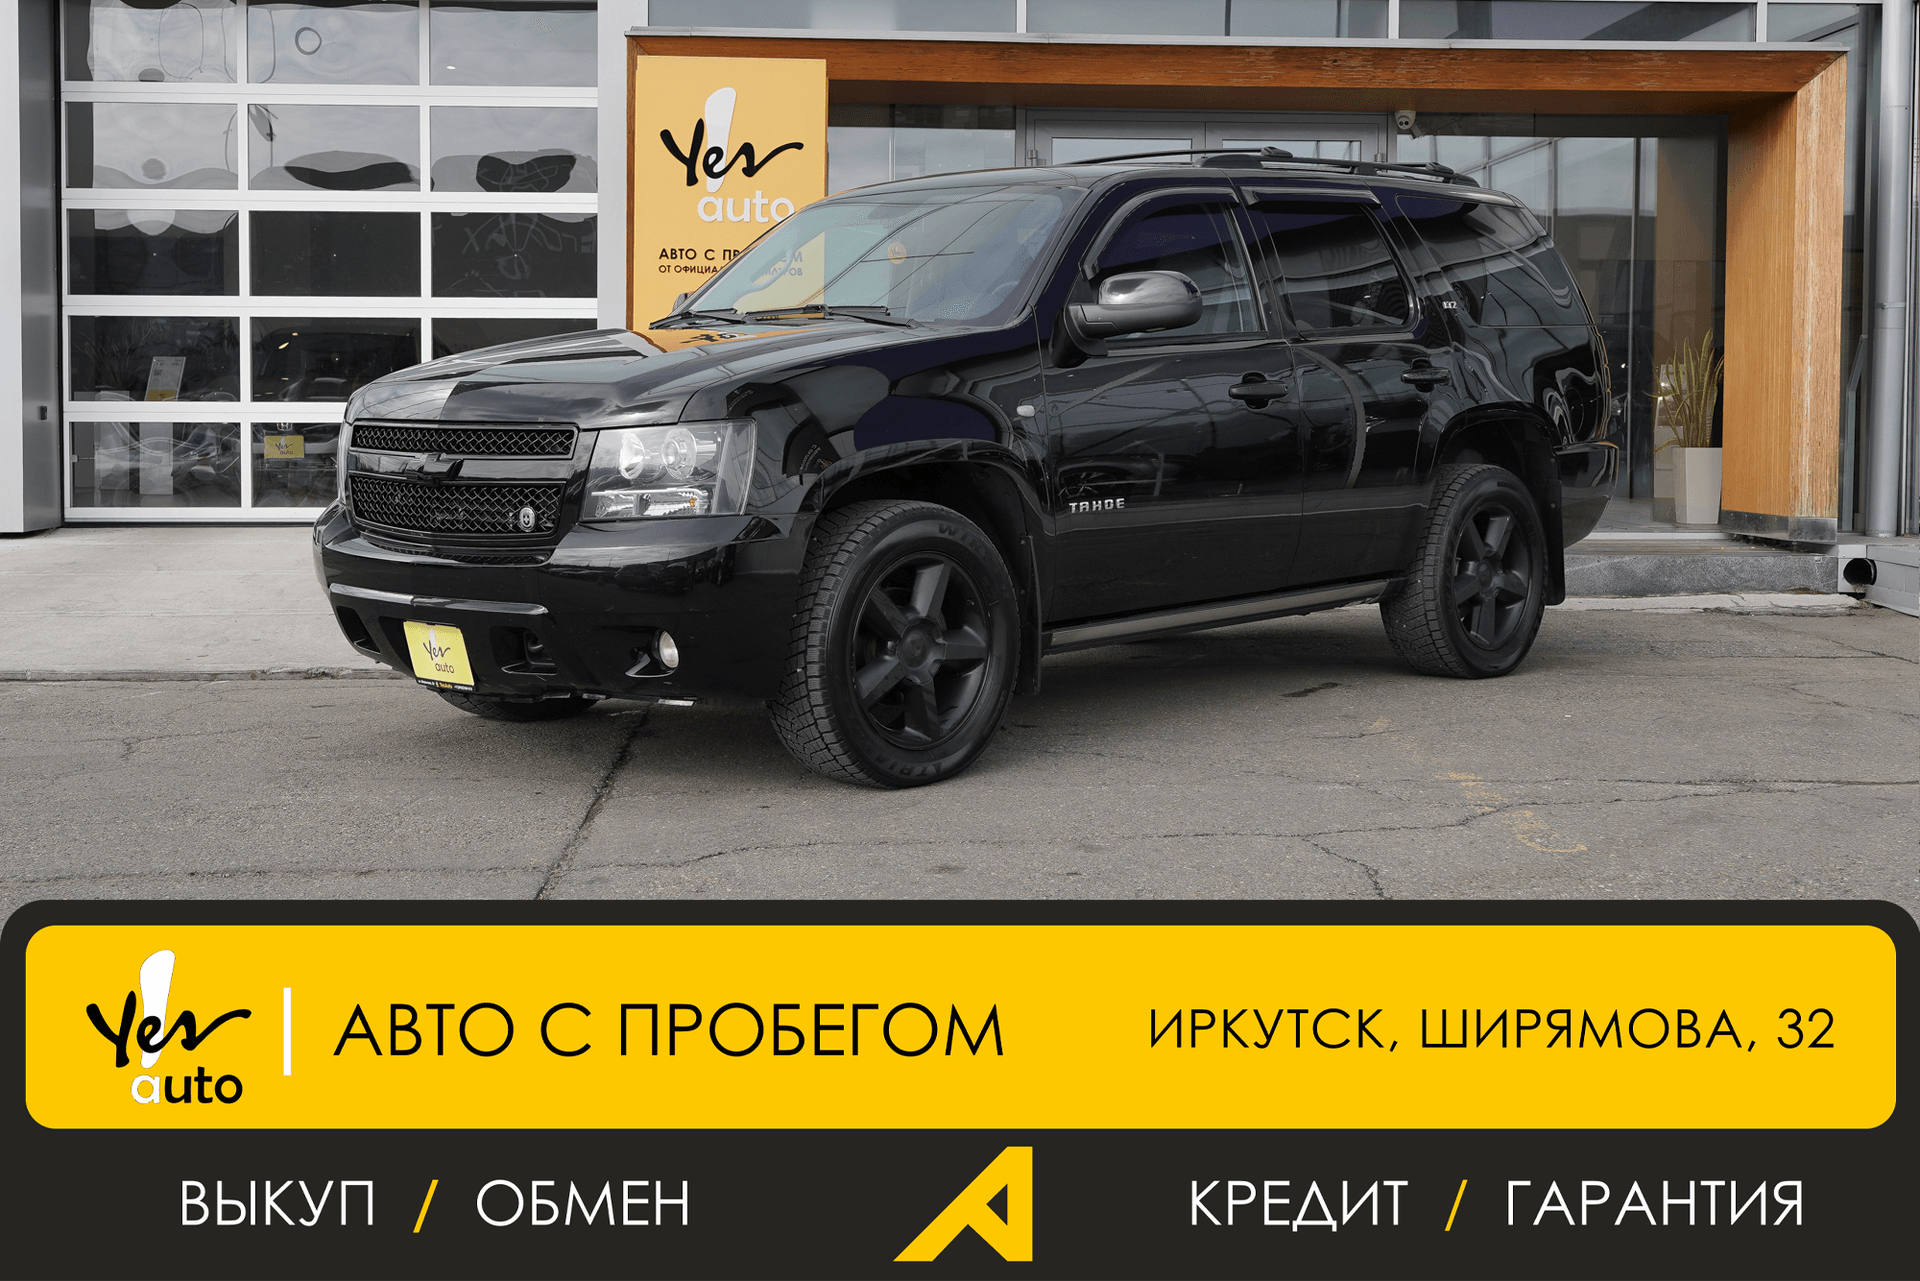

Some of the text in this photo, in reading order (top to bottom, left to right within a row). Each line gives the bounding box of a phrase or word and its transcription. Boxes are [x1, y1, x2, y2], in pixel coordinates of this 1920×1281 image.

[697, 190, 796, 223] auto
[658, 248, 697, 260] АВТО
[704, 248, 715, 261] С
[658, 264, 724, 275] ОТ ОФИЦИА
[1068, 498, 1125, 514] TAHOE
[434, 662, 455, 674] auto
